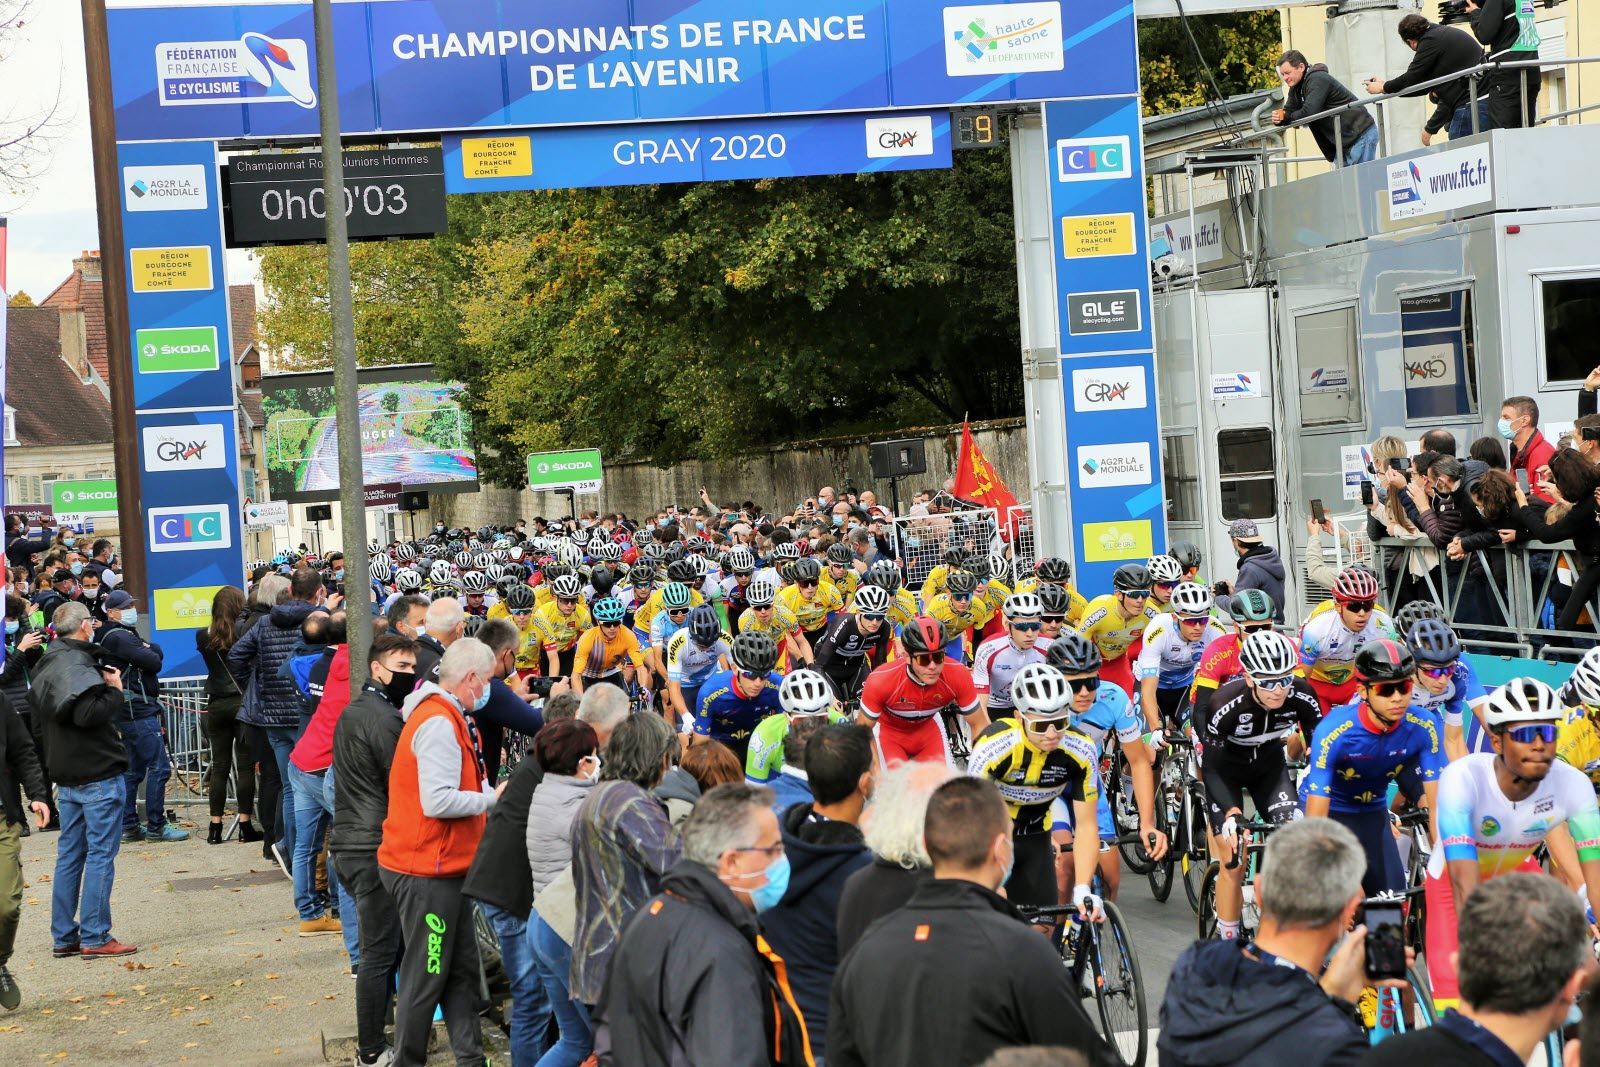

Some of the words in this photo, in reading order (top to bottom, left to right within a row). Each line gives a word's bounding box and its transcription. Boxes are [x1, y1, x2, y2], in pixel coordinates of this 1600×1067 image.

[995, 17, 1035, 35] haute
[392, 23, 669, 60] CHAMPIONNATS
[678, 19, 723, 47] DE
[733, 15, 865, 46] FRANCE
[1007, 28, 1048, 48] saône
[166, 47, 237, 60] FÉDÉRATION
[167, 62, 239, 76] FRANÇAISE
[529, 65, 577, 92] DE
[588, 57, 739, 89] L'AVENIR
[169, 84, 177, 95] DE
[178, 81, 241, 95] CYCLISME
[878, 130, 918, 149] GRAY
[612, 138, 701, 166] GRAY
[709, 133, 787, 162] 2020
[1067, 147, 1118, 170] CIC
[236, 160, 305, 173] Championnat
[342, 157, 379, 168] Juniors
[382, 154, 429, 166] Hommes
[479, 159, 512, 167] FRANCHE
[150, 180, 176, 189] AG2R
[178, 179, 190, 188] LA
[1429, 158, 1488, 194] www.ffc.fr
[150, 188, 199, 198] MONDIALE
[161, 341, 211, 355] ŠKODA
[1085, 381, 1131, 402] GRAY
[362, 429, 396, 440] UGER
[156, 440, 208, 462] GRAY
[551, 461, 593, 472] ŠKODA
[1100, 457, 1124, 466] AG2R
[1125, 457, 1137, 465] LA
[1100, 464, 1144, 475] MONDIALE
[160, 516, 216, 540] CIC
[669, 636, 684, 663] MAVIC
[1211, 694, 1244, 727] SCOTT
[427, 933, 442, 975] asics
